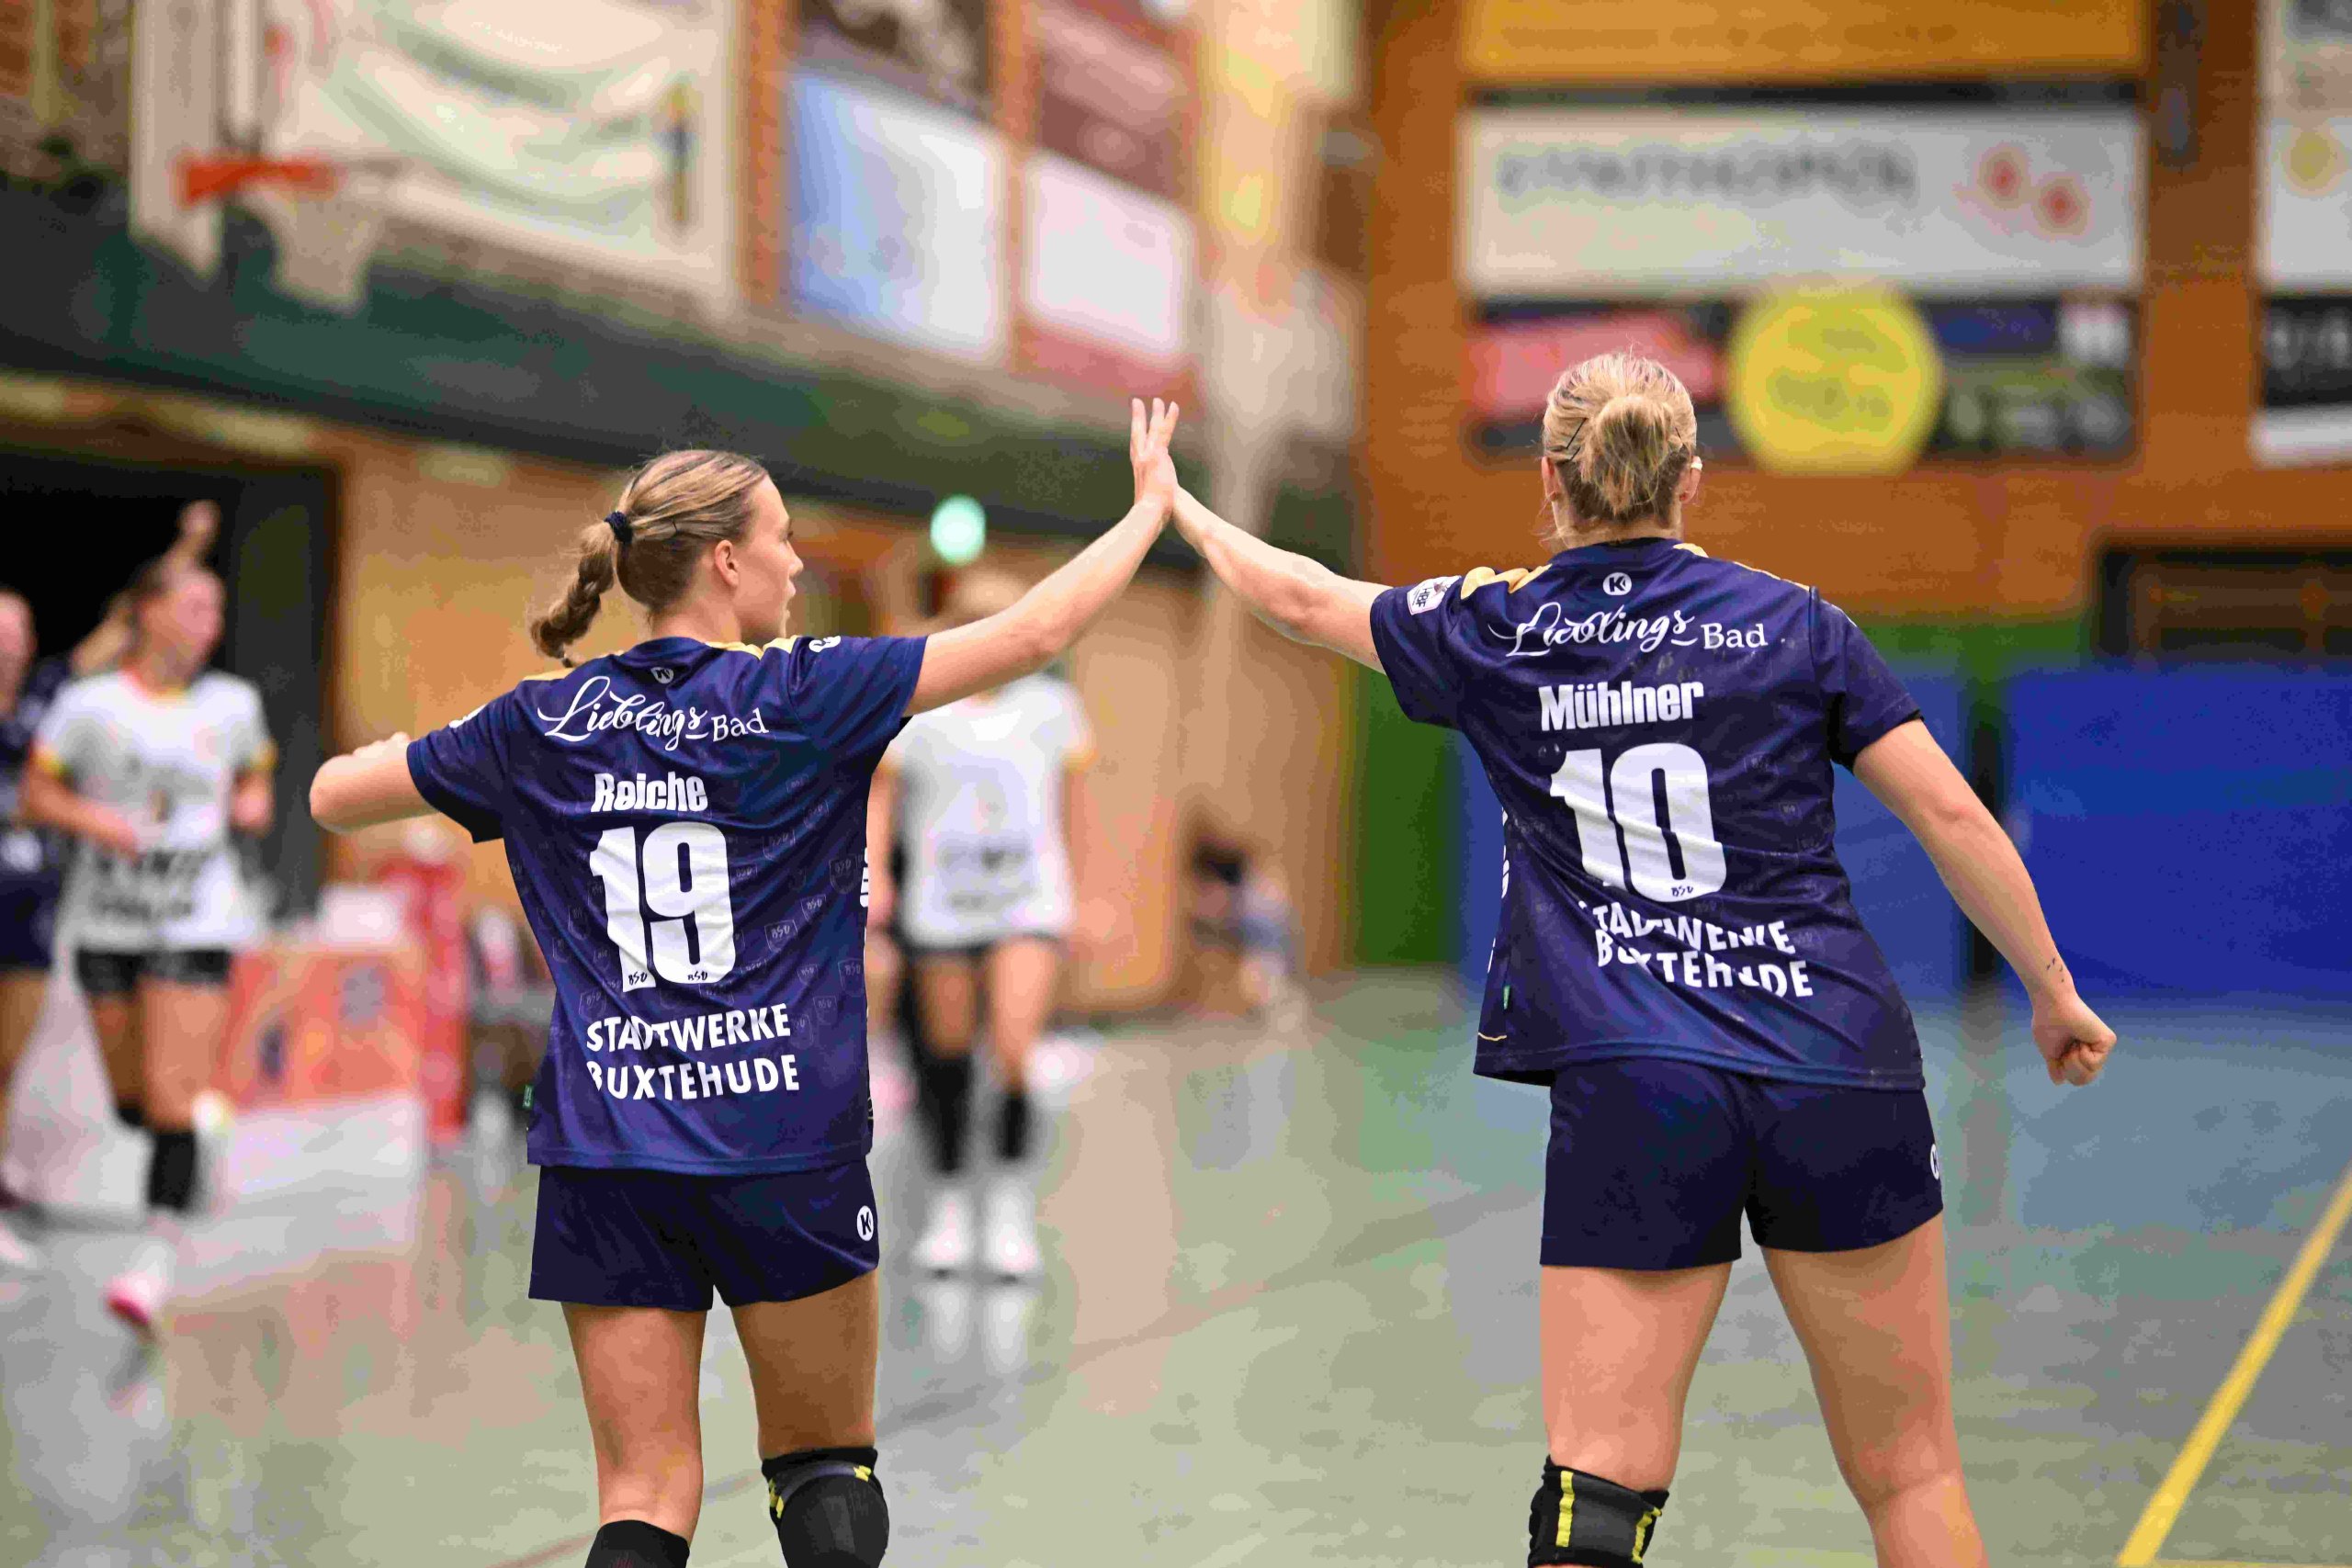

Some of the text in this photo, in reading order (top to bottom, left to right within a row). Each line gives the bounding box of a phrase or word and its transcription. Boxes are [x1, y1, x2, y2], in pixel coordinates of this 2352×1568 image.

[1701, 623, 1769, 650] Bad
[537, 675, 769, 751] Lieblings Bad
[1538, 680, 1704, 731] Mühlner
[590, 771, 708, 812] Reiche
[1550, 742, 1727, 903] 10
[589, 821, 736, 992] 19
[586, 1003, 791, 1053] STADTWERKE
[586, 1055, 799, 1101] BUXTEHUDE
